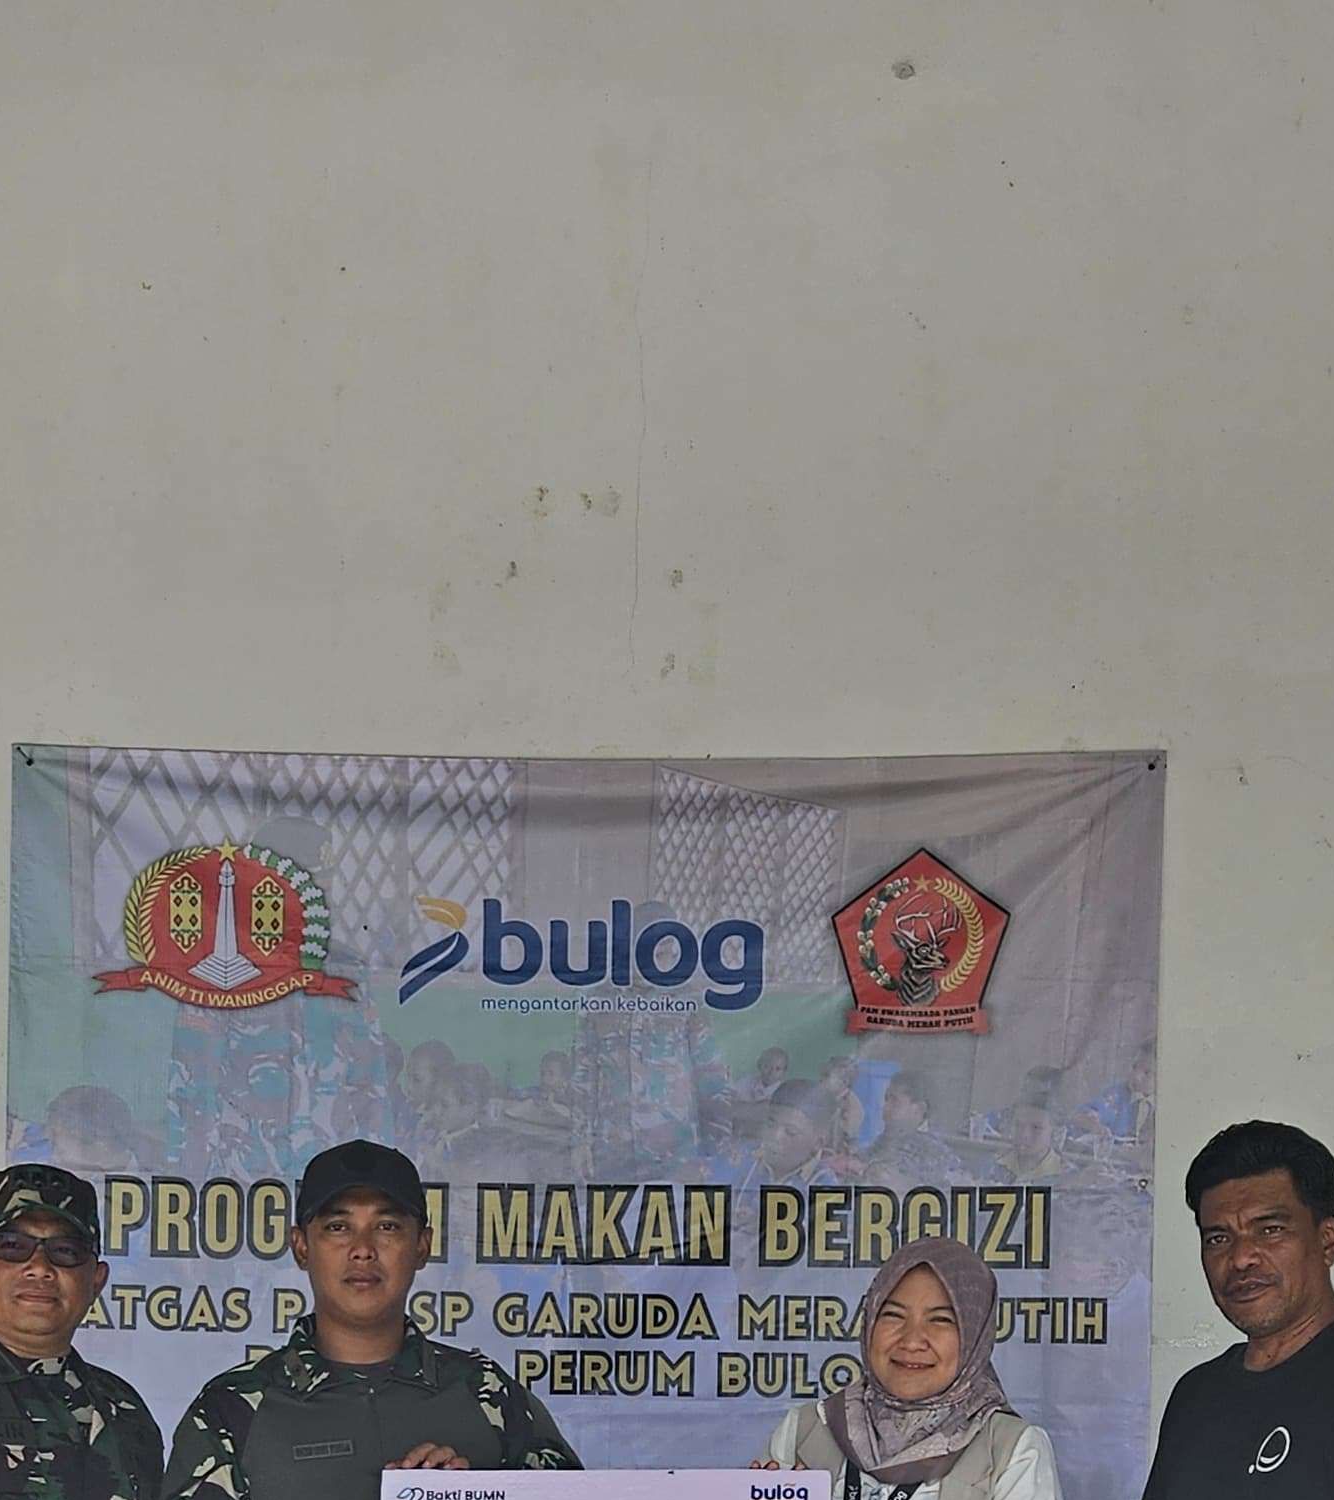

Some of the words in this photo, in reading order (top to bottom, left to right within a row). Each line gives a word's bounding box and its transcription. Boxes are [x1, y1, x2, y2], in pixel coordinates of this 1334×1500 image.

[482, 898, 764, 1011] bulog
[140, 970, 188, 998] ANIM
[189, 990, 204, 1004] TI
[208, 973, 315, 1009] WANINGGAP
[482, 997, 612, 1014] mengantarkan
[618, 995, 697, 1012] kebaikan
[866, 1016, 904, 1027] GARUDA
[907, 1016, 942, 1028] MERAH
[944, 1016, 974, 1027] PUTIH
[476, 1183, 731, 1266] MAKAN
[759, 1185, 1051, 1269] BERGIZI
[408, 1291, 474, 1337] SP
[492, 1292, 720, 1341] GARUDA
[516, 1348, 695, 1398] PERUM
[426, 1489, 461, 1500] Bakti
[465, 1489, 506, 1500] BUMN
